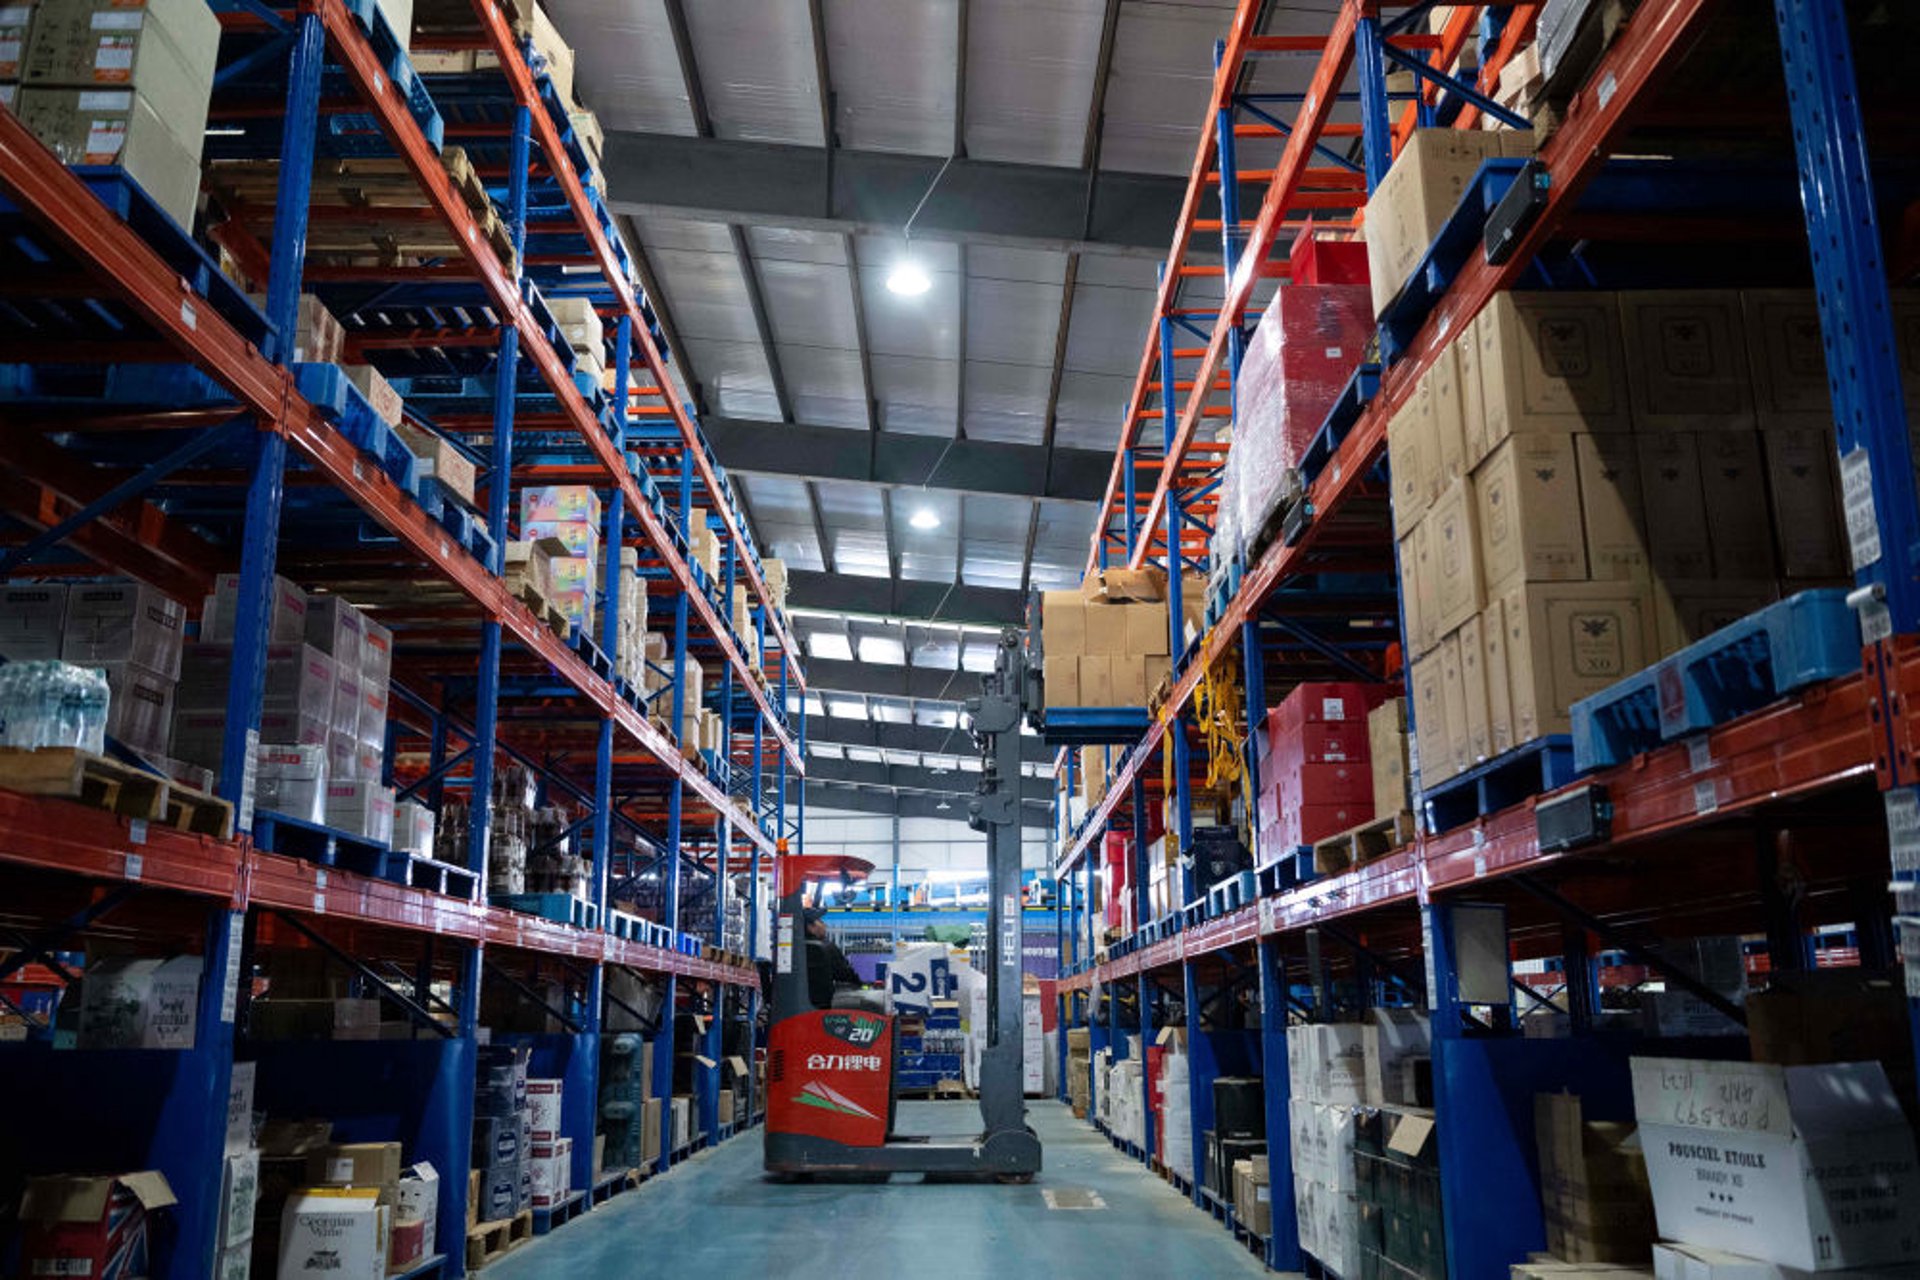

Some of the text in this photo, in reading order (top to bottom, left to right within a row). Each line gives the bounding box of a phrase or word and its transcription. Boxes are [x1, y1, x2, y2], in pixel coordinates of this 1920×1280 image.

[1587, 657, 1611, 669] XO
[1003, 918, 1015, 966] HELI
[848, 1028, 874, 1042] 20
[807, 1053, 881, 1072] 合力锂电
